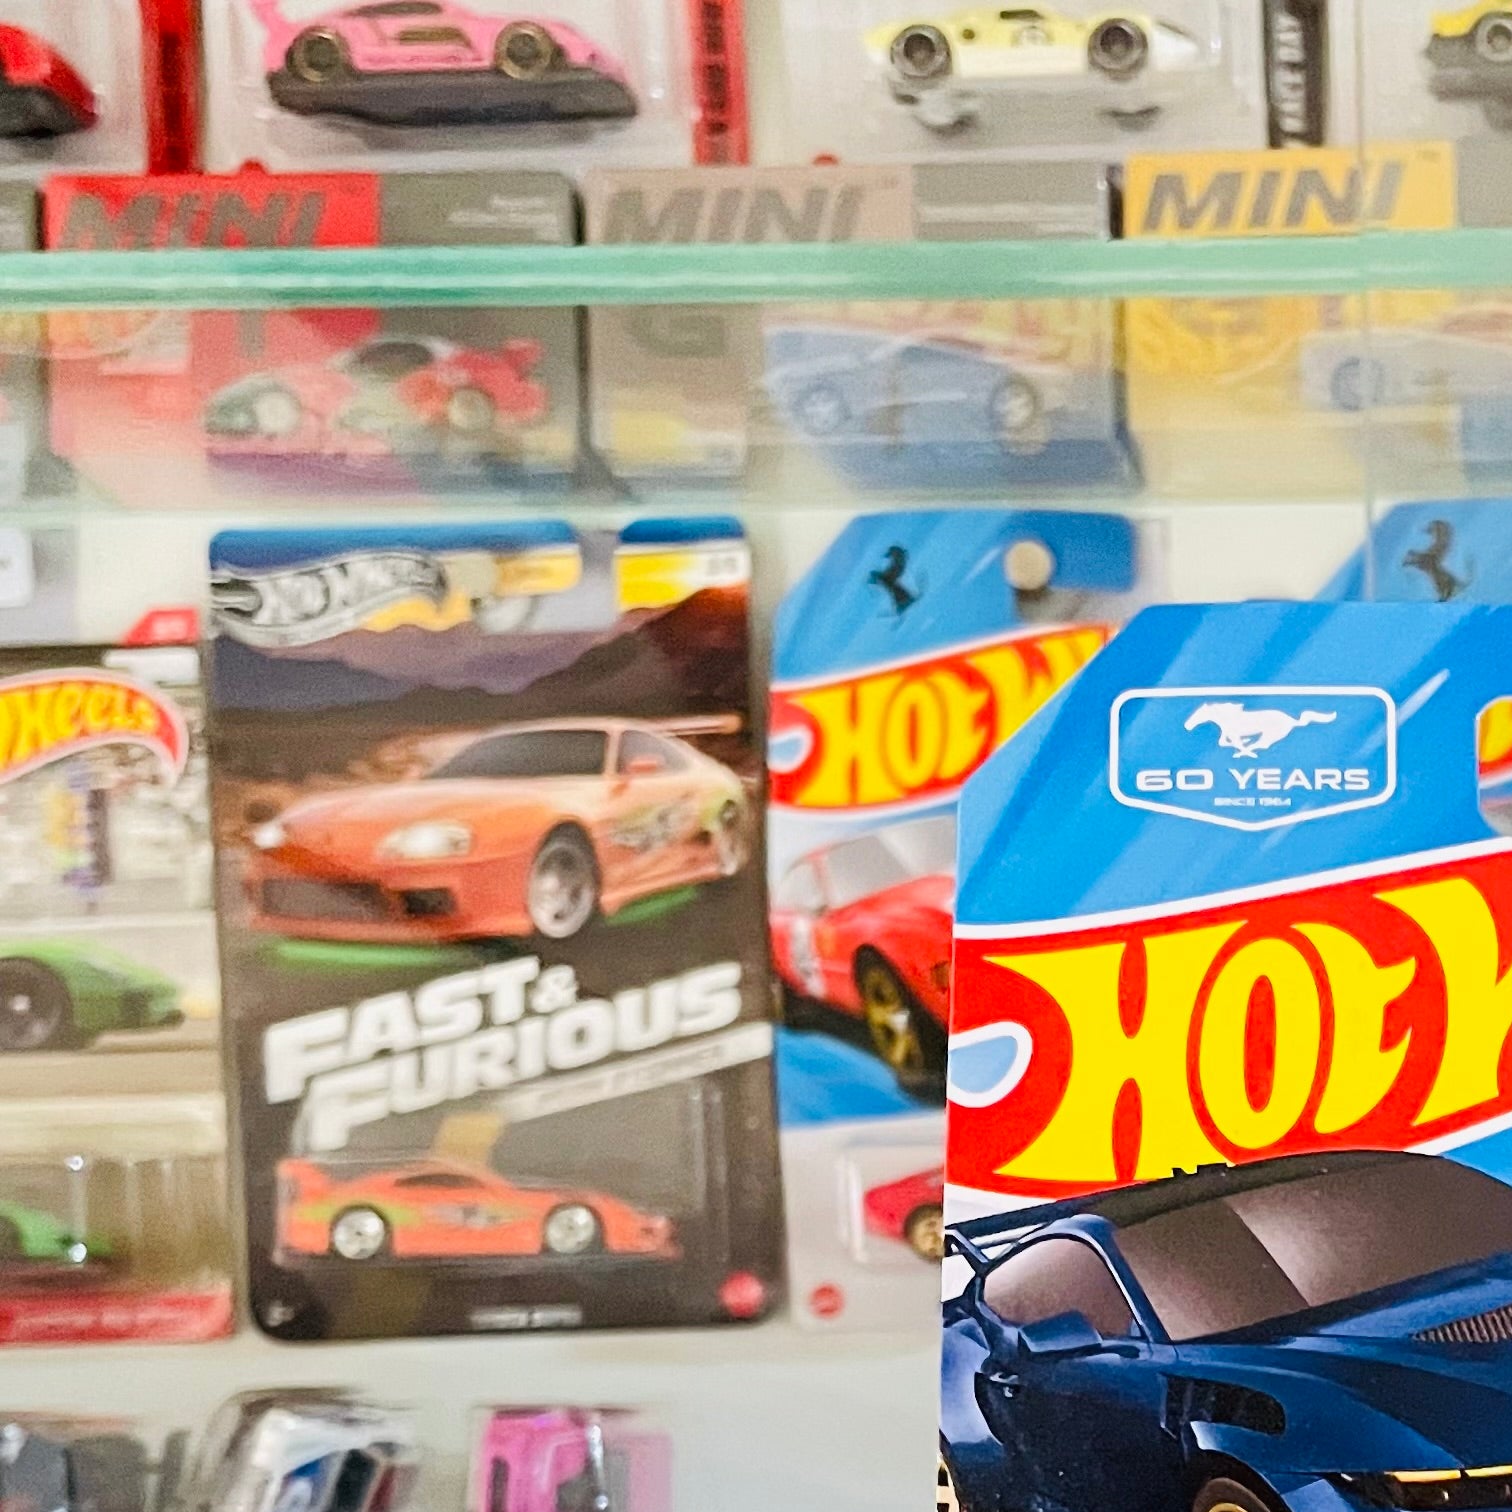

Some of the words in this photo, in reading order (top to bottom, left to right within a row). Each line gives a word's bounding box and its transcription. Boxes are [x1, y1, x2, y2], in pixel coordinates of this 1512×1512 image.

[1142, 160, 1406, 231] MINI
[796, 655, 996, 806] HOT
[1136, 770, 1214, 791] 60
[1229, 768, 1370, 791] YEARS
[264, 955, 540, 1104] FAST
[531, 964, 580, 1014] &
[308, 961, 741, 1151] FURIOUS
[983, 921, 1417, 1182] HOT
